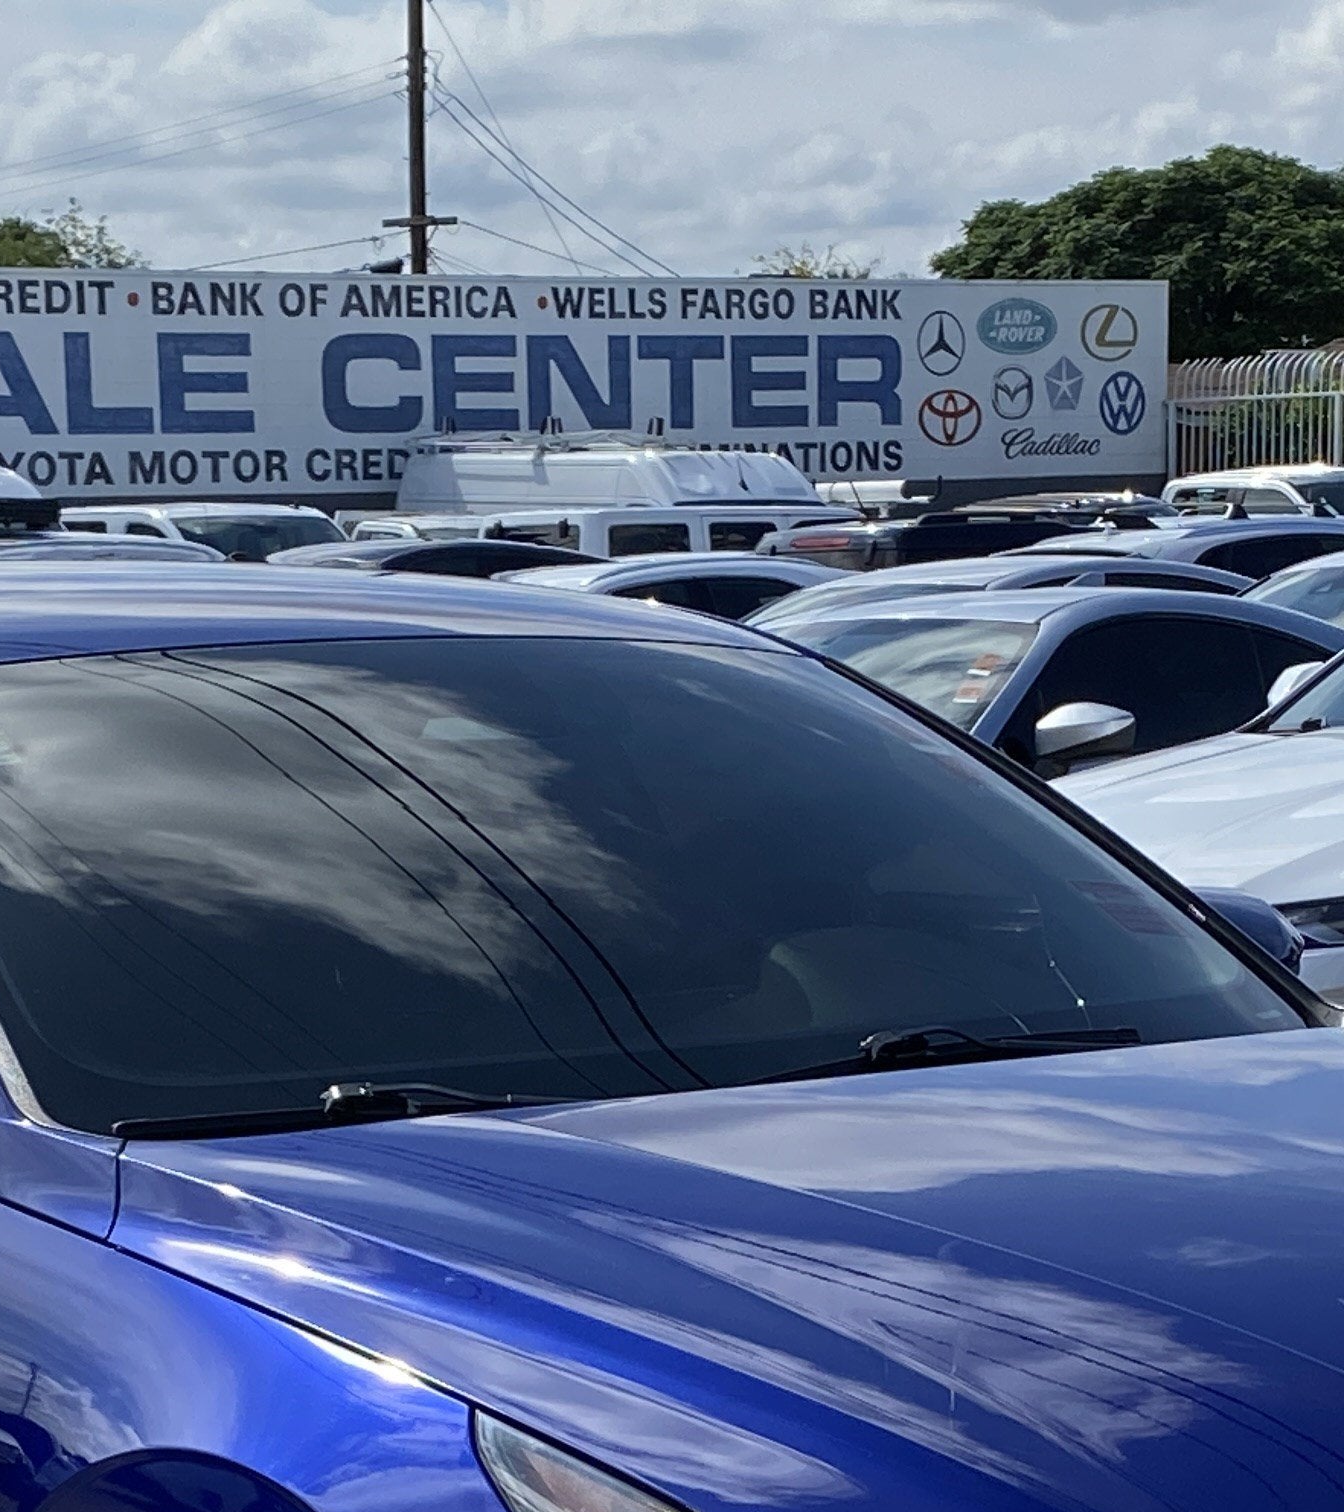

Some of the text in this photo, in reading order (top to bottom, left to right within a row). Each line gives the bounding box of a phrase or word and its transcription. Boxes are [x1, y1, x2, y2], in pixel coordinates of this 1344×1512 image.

[151, 281, 263, 317] BANK
[279, 284, 328, 317] OF
[341, 284, 517, 319] AMERICA
[550, 287, 667, 319] WELLS
[680, 289, 795, 320] FARGO
[809, 290, 902, 320] BANK
[995, 309, 1033, 325] LAND
[999, 326, 1045, 342] ROVER
[321, 332, 902, 432] CENTER
[1001, 427, 1101, 460] Cadillac
[128, 450, 289, 485] MOTOR
